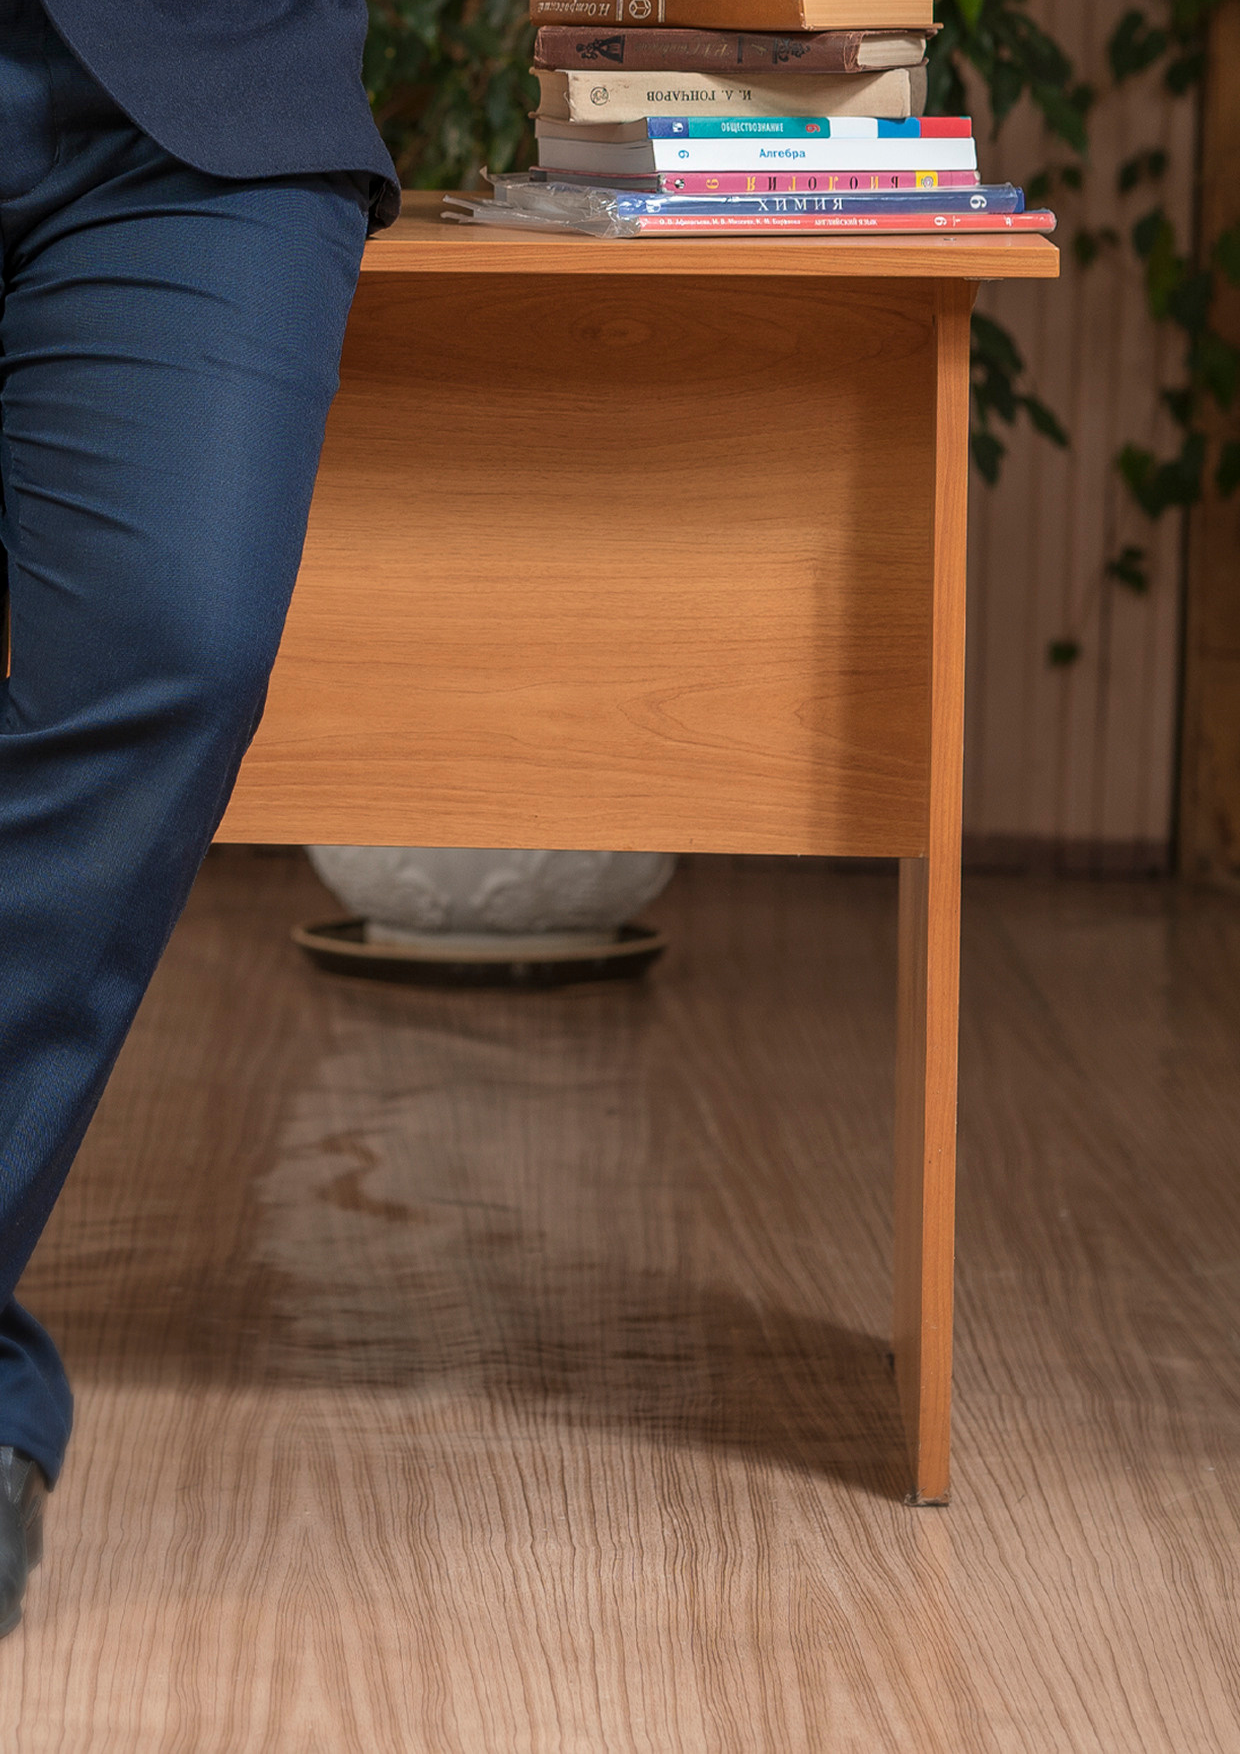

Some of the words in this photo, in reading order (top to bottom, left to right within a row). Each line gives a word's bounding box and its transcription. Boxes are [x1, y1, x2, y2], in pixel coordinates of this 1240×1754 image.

[646, 90, 716, 102] ГОНЧАРОВ
[720, 122, 784, 133] ОБЩЕСТВОЗНАНИЕ
[759, 148, 806, 160] Алгебра
[746, 175, 899, 192] БИОЛОГИЯ
[758, 197, 843, 211] ХИМИЯ
[969, 195, 988, 210] 9
[934, 216, 948, 227] 9
